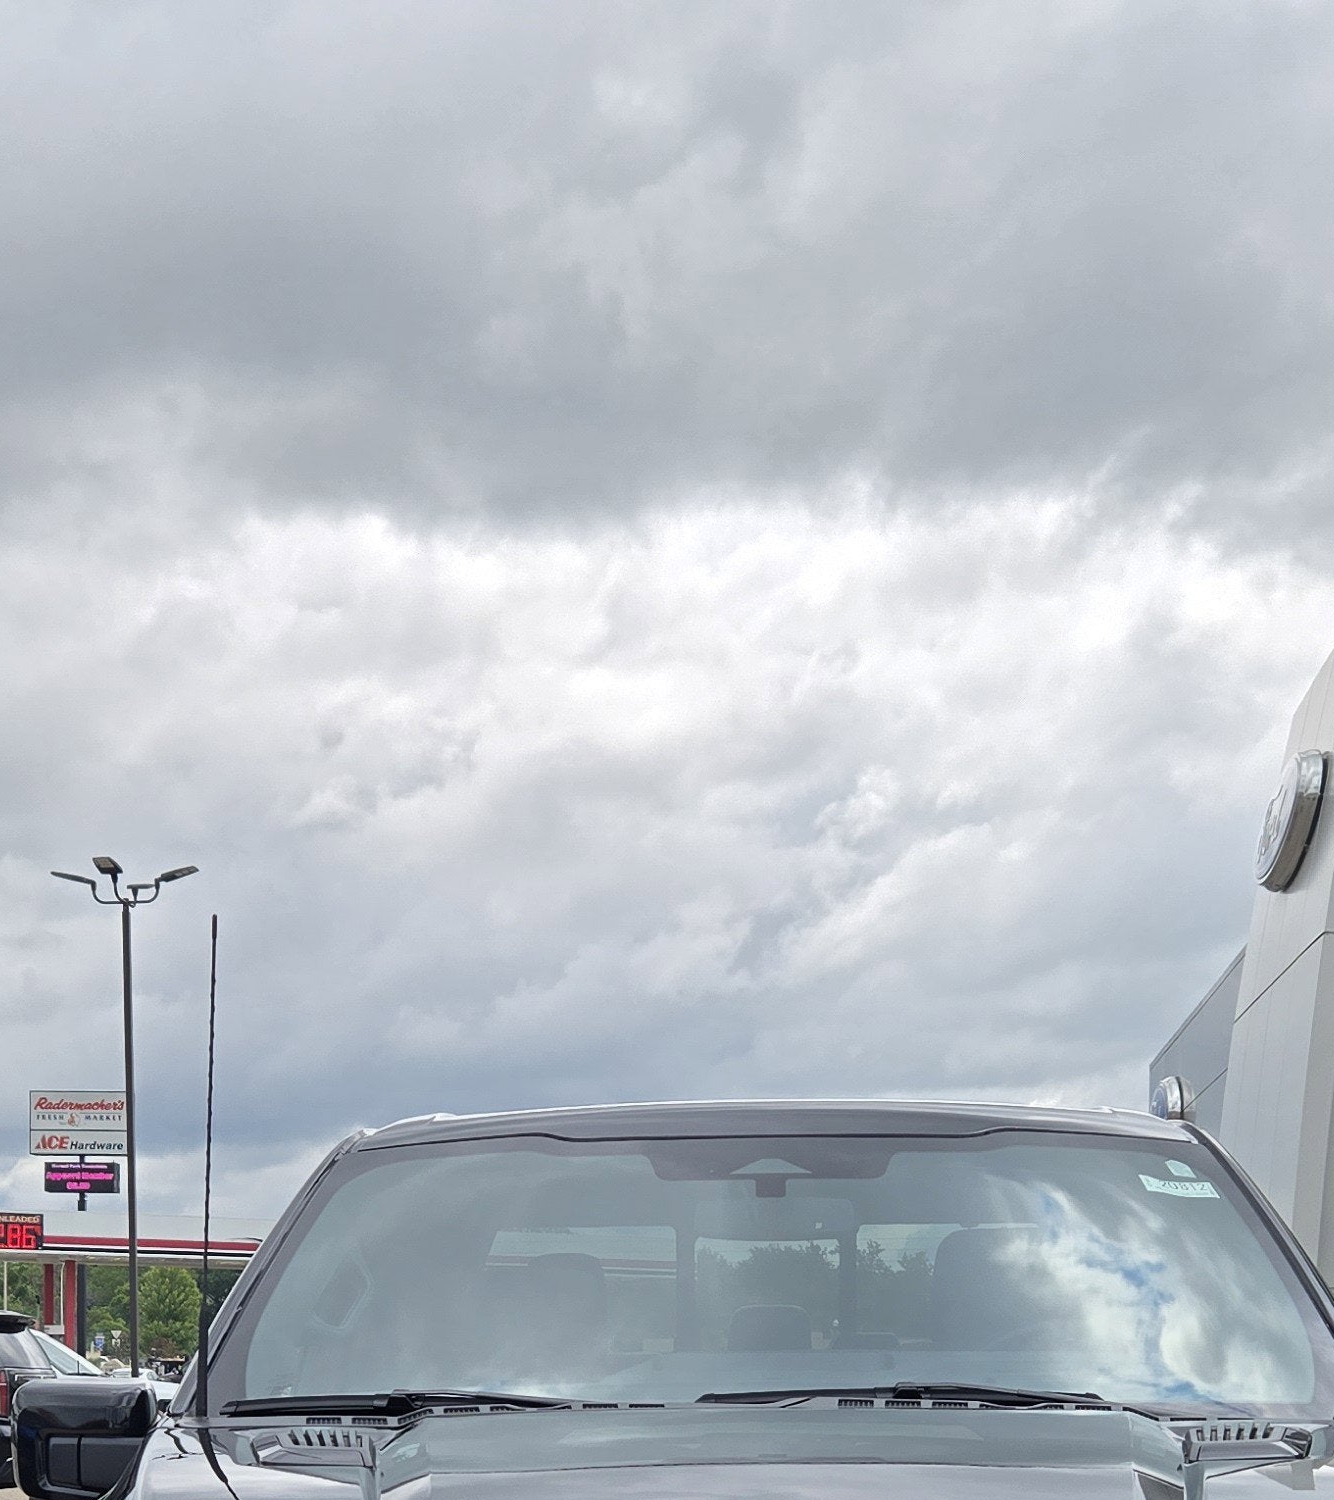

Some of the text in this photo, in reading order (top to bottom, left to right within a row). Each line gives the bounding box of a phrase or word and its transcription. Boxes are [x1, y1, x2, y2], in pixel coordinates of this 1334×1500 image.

[34, 1097, 124, 1110] Radermacher's
[35, 1134, 123, 1150] ACE Hardware
